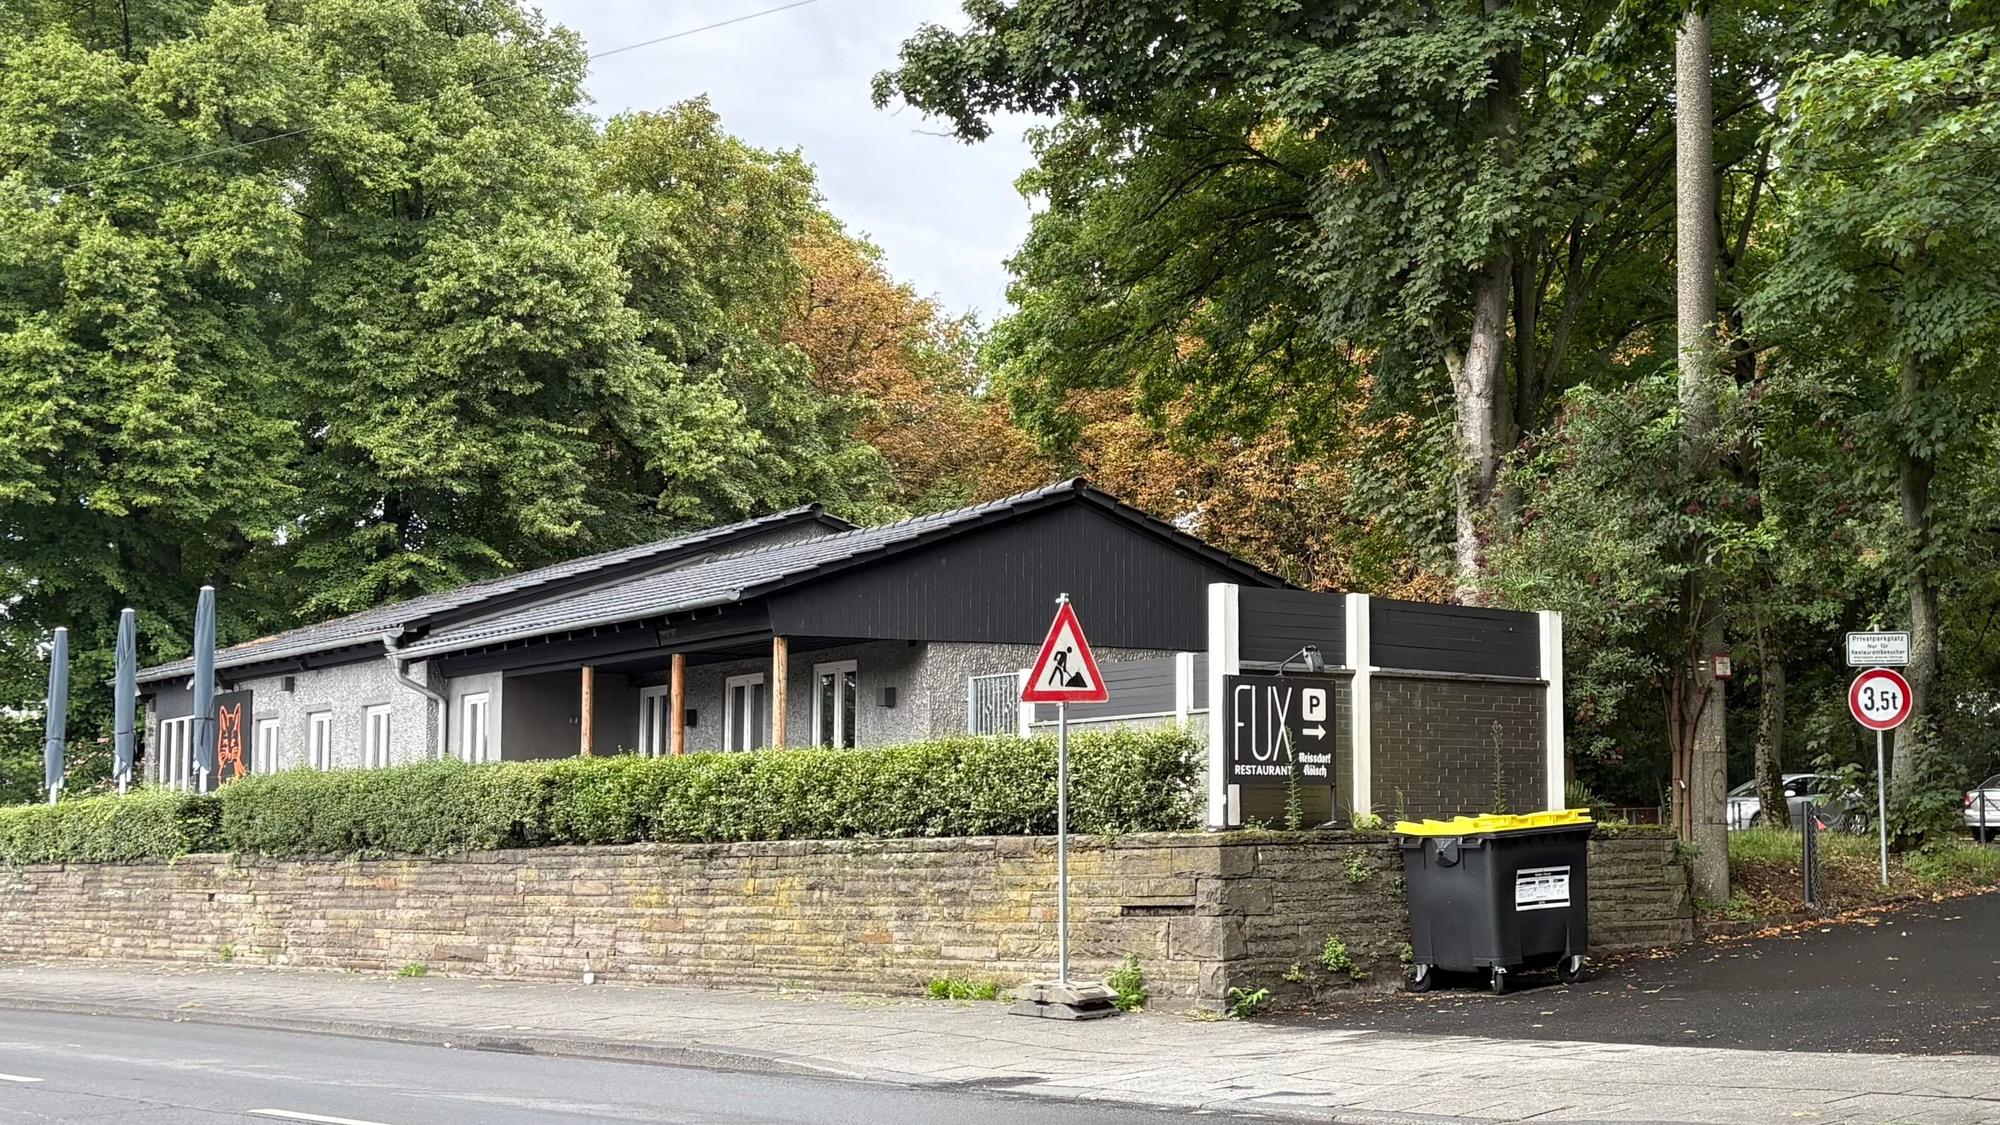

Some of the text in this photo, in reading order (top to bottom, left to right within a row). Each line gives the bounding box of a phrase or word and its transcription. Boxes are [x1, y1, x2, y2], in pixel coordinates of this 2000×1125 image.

[1309, 695, 1321, 714] P
[1234, 684, 1293, 762] FUX
[1298, 752, 1332, 763] Reissdorf
[1234, 764, 1292, 776] RESTAURANT
[1303, 764, 1327, 778] Kölsch
